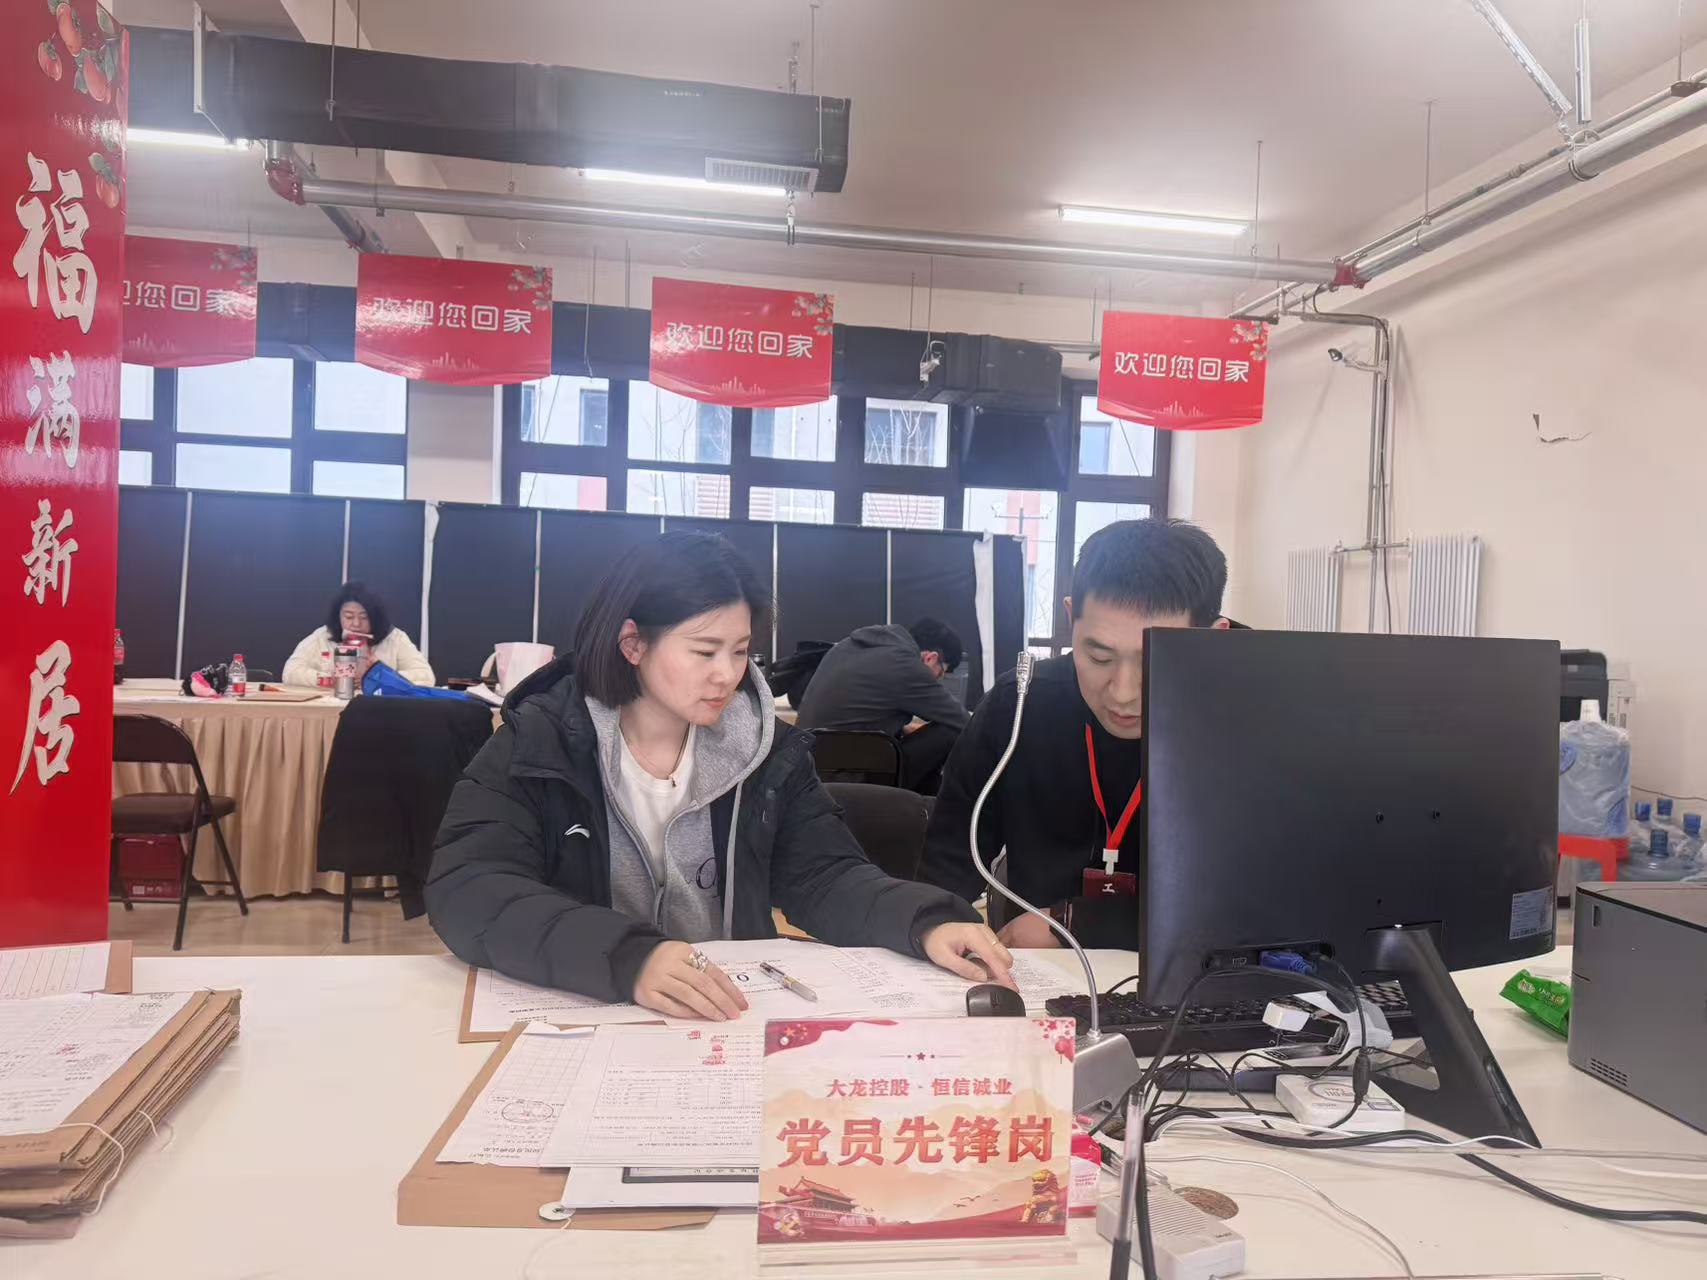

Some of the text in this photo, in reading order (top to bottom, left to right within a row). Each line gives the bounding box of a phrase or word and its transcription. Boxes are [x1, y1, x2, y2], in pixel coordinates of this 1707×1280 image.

[373, 297, 532, 334] 欢迎您回家
[666, 321, 814, 359] 欢迎您回家
[1114, 351, 1250, 383] 欢迎您回家
[10, 152, 98, 796] 福满新居
[776, 1115, 1055, 1168] 党员先锋岗
